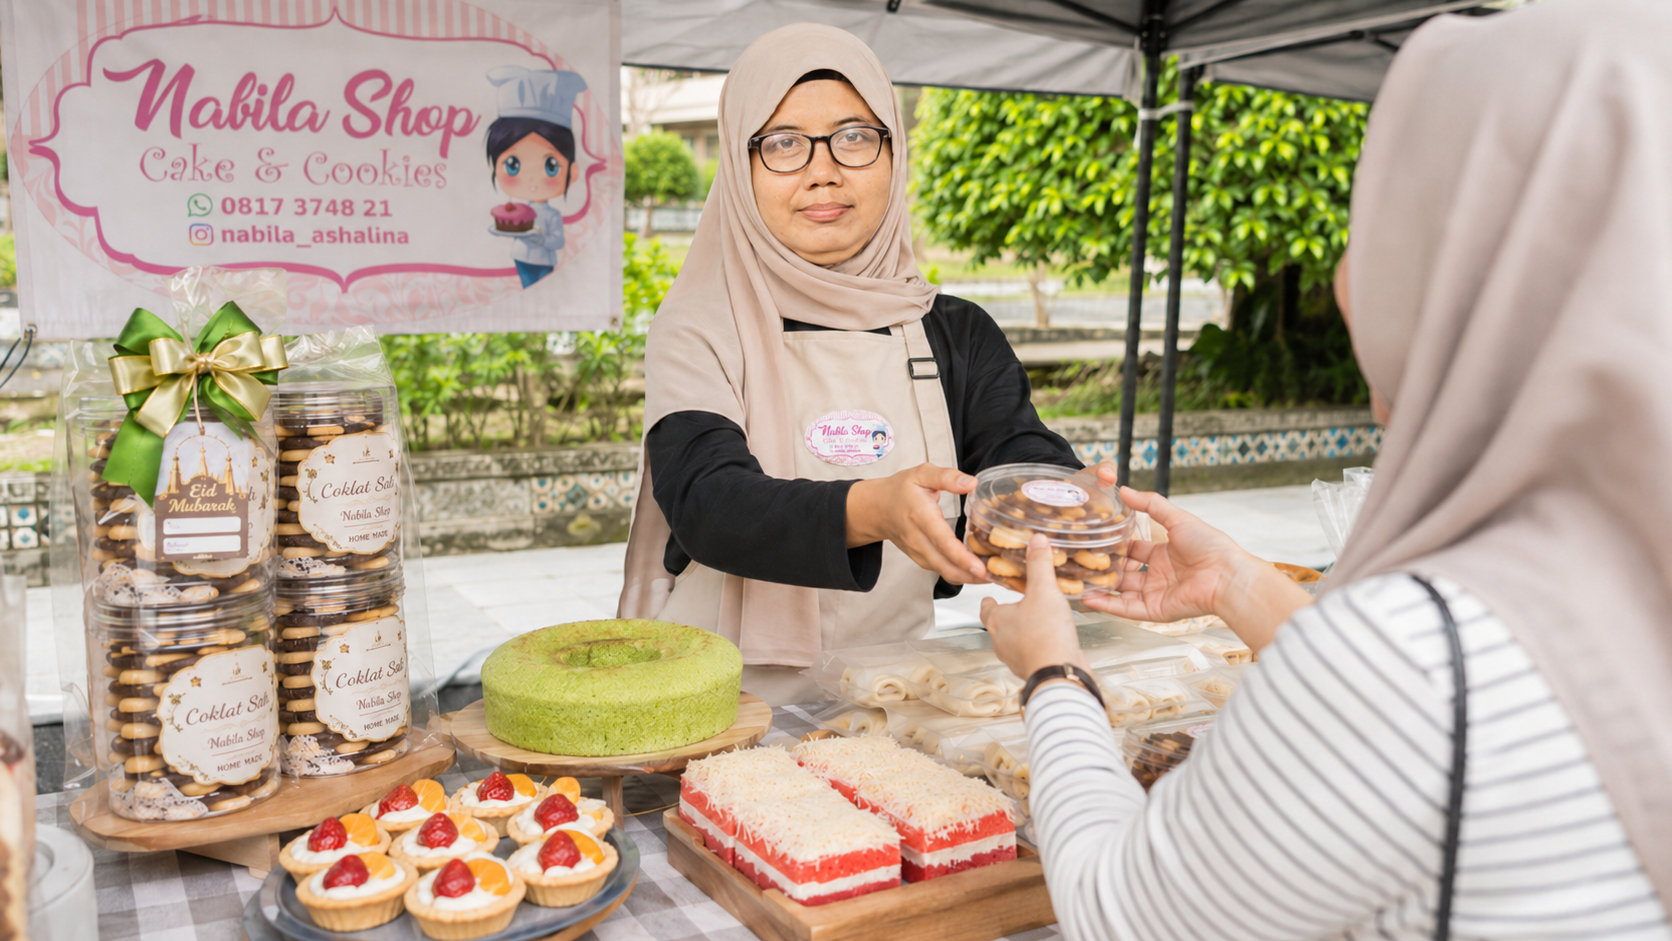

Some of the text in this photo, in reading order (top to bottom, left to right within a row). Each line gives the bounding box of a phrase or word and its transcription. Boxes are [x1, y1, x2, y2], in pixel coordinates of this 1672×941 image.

[102, 58, 482, 158] Nabila Shop
[139, 143, 447, 190] Cake & Cookies
[221, 197, 391, 217] 0817 3748 21
[221, 225, 410, 248] nabila_ashalina
[190, 483, 217, 498] Eid
[321, 480, 372, 499] Coklat
[168, 498, 236, 513] Mubarak
[340, 509, 372, 521] Nabila
[348, 534, 370, 543] HOME
[336, 667, 383, 689] Coklat
[357, 696, 385, 710] Nabila
[186, 702, 243, 726] Coklat
[207, 733, 244, 749] Nabila
[217, 761, 241, 772] HOME
